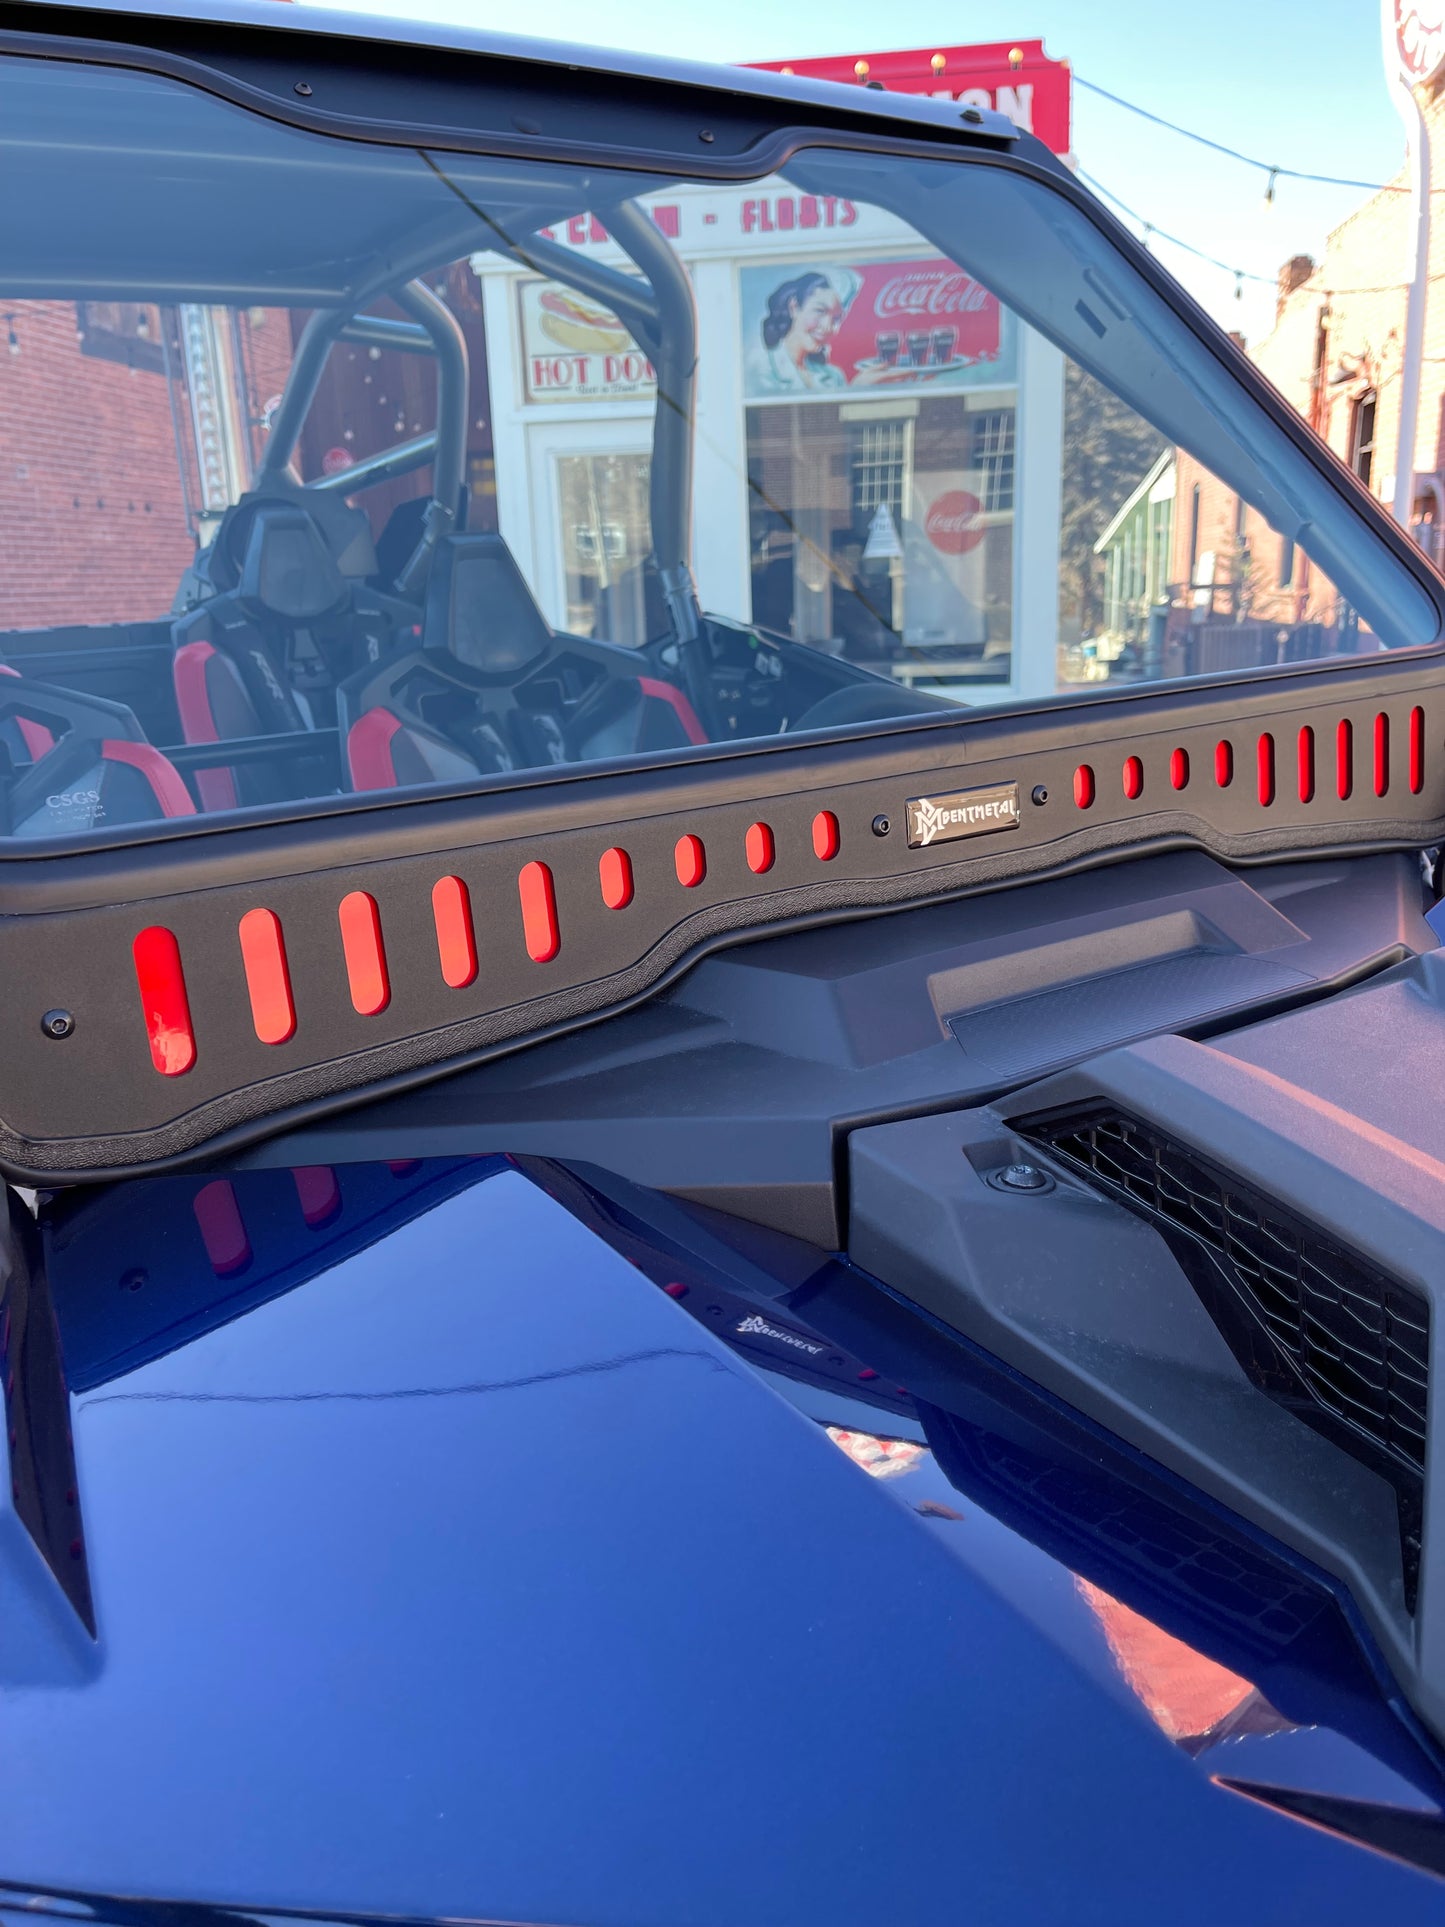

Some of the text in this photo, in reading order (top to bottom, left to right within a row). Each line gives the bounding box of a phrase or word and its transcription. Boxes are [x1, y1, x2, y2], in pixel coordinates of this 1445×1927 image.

[742, 195, 858, 233] FLOATS
[533, 357, 591, 386] HOT
[942, 799, 1016, 825] BENTMETAL
